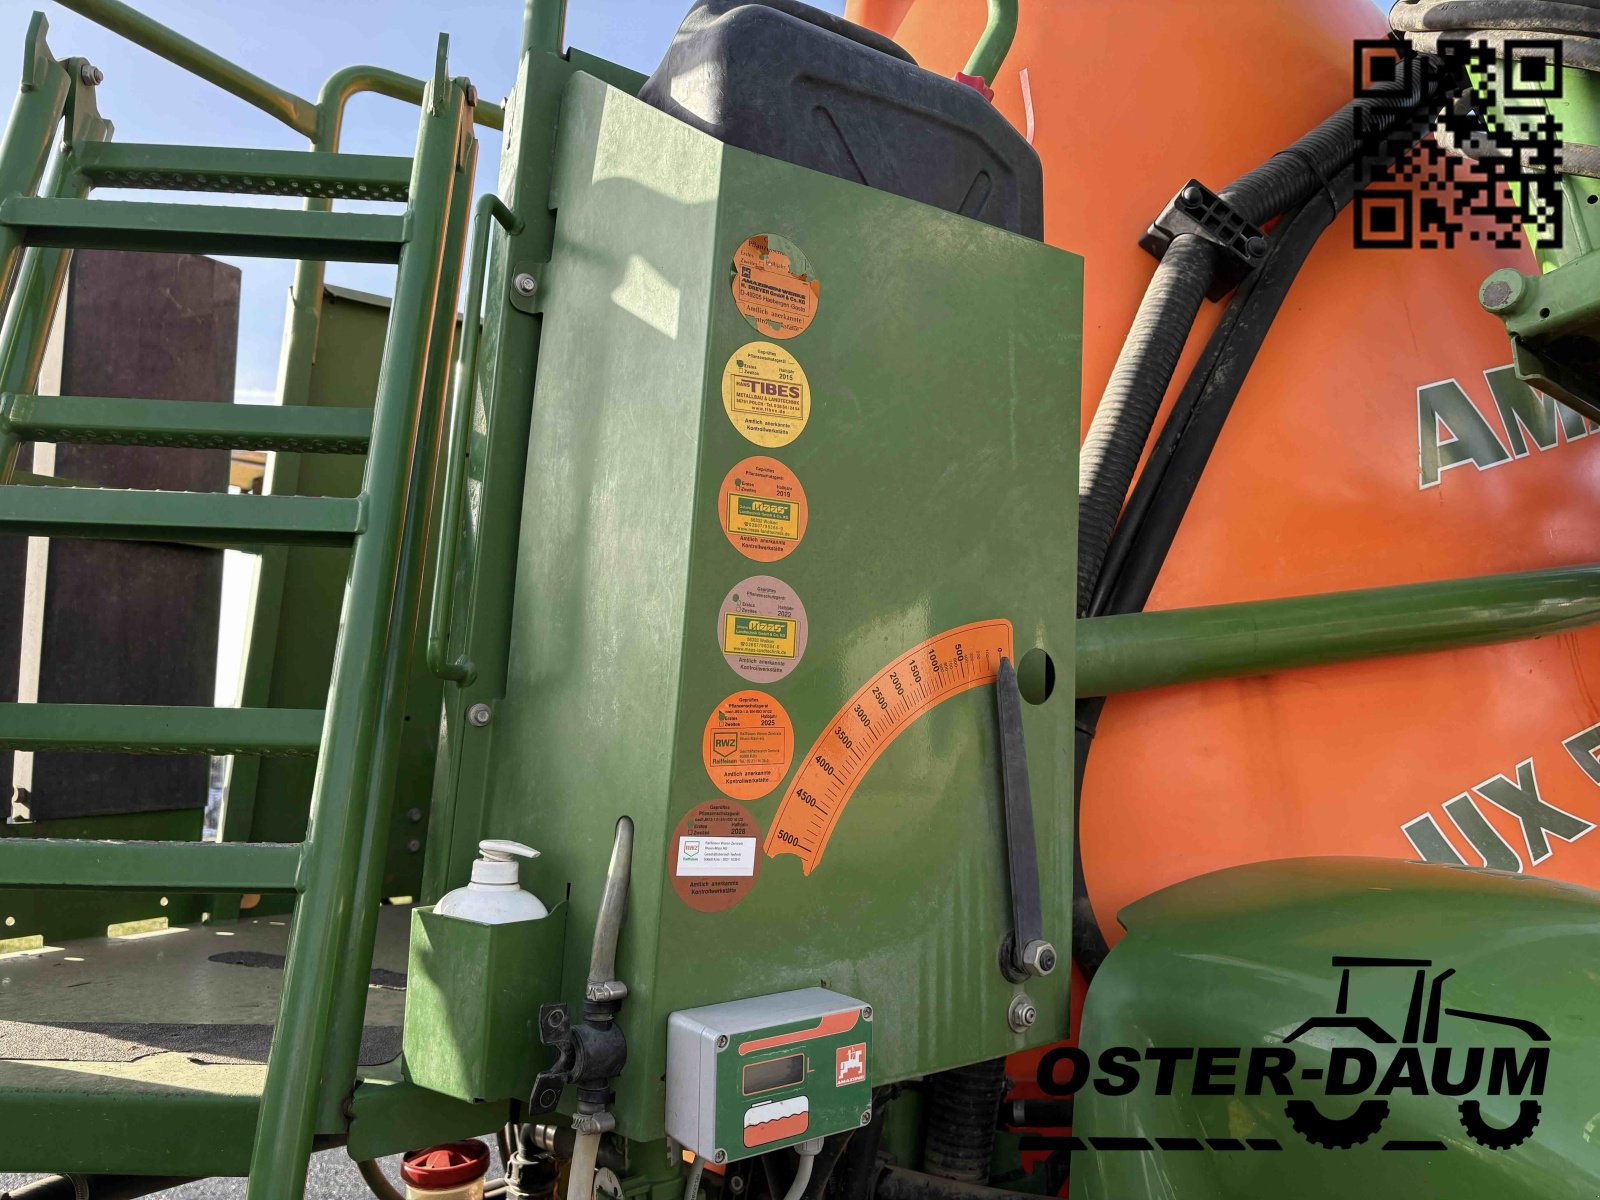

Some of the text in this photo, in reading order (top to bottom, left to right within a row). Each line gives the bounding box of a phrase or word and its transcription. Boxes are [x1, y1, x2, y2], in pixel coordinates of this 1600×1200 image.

[748, 285, 769, 294] DREYER
[746, 304, 802, 323] Amtlich anerkannte
[736, 392, 763, 400] METALLBAU
[768, 397, 800, 405] LANDTECHNIK
[741, 379, 800, 399] TIBES
[928, 649, 939, 672] 1000
[955, 644, 964, 661] 500
[909, 660, 922, 683] 1500
[889, 671, 905, 696] 2000
[872, 686, 888, 710] 2500
[854, 704, 871, 727] 3000
[715, 739, 735, 747] RWZ
[835, 726, 853, 749] 3500
[815, 755, 834, 775] 4000
[796, 788, 816, 807] 4500
[777, 829, 799, 847] 5000
